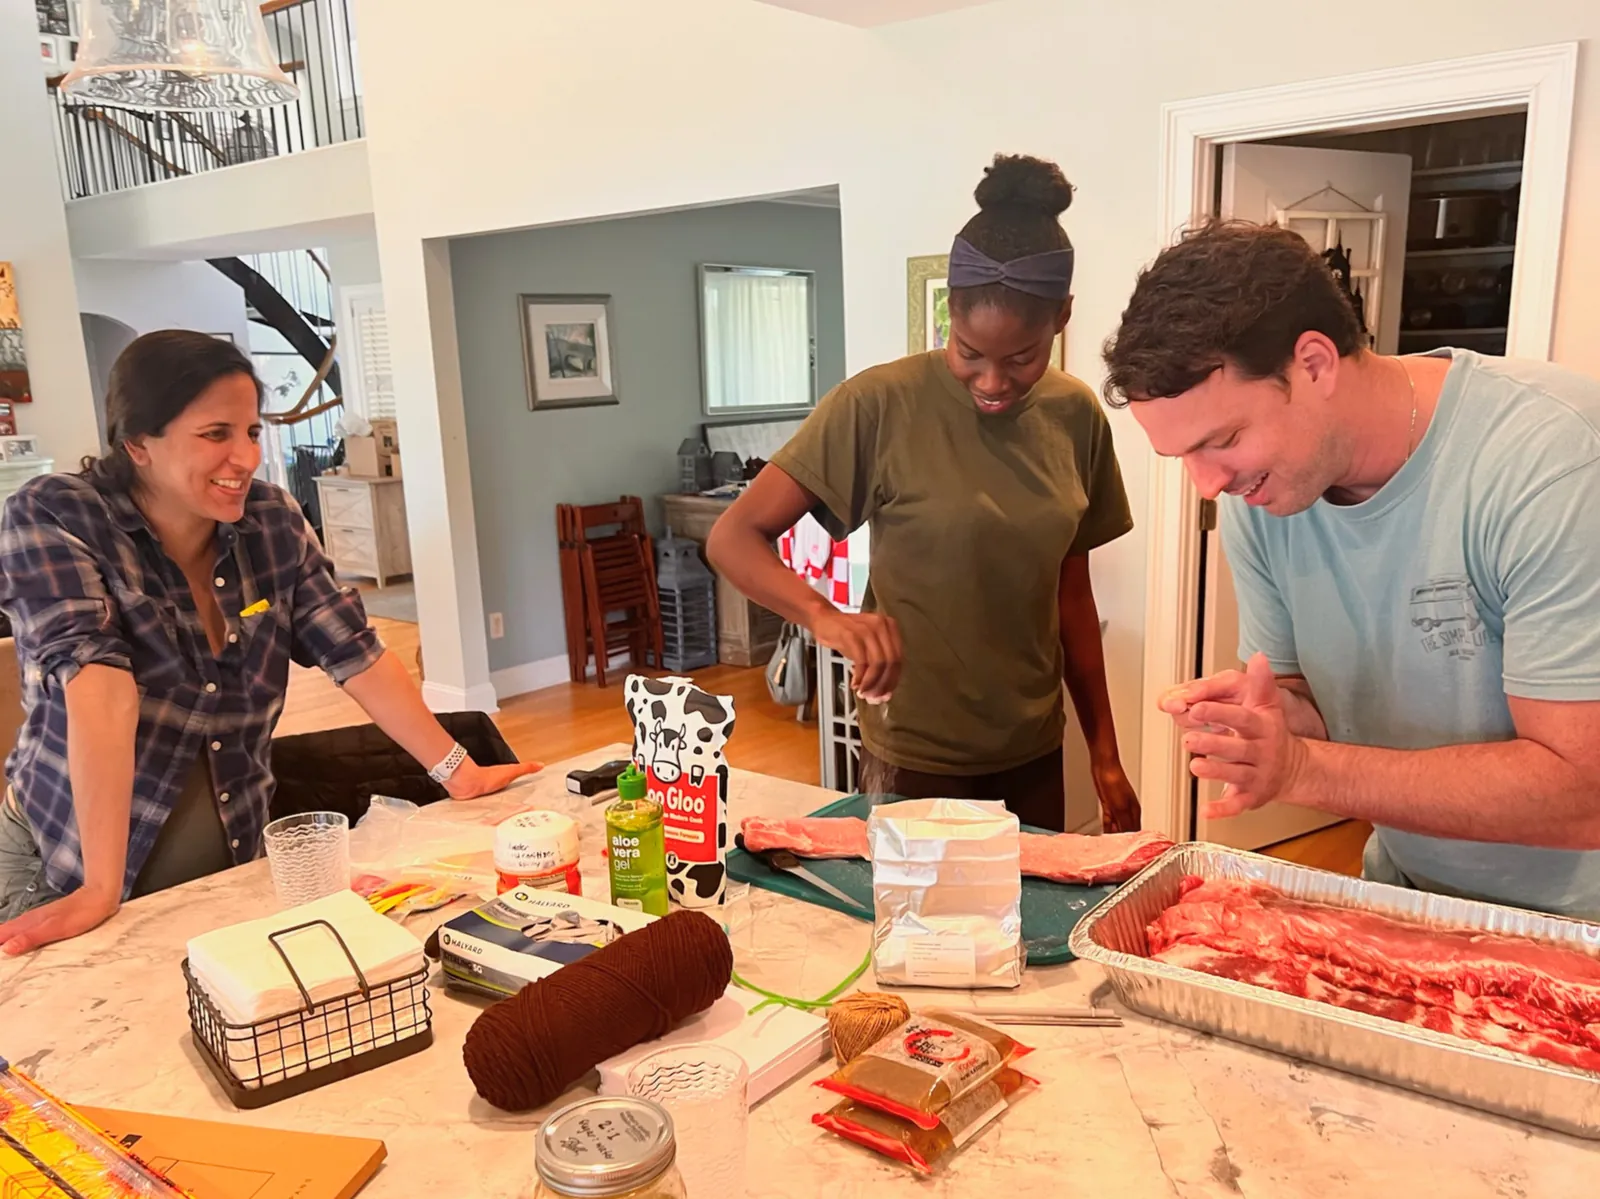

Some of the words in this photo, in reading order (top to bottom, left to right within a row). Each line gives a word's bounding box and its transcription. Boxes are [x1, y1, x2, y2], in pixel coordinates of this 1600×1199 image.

[1439, 628, 1471, 646] SIMP
[647, 788, 665, 806] oo
[666, 786, 705, 815] Gloo
[612, 834, 640, 847] aloe
[612, 847, 641, 858] vera
[614, 858, 630, 871] gel
[528, 900, 570, 909] HALYARD
[451, 939, 483, 955] HALYARD
